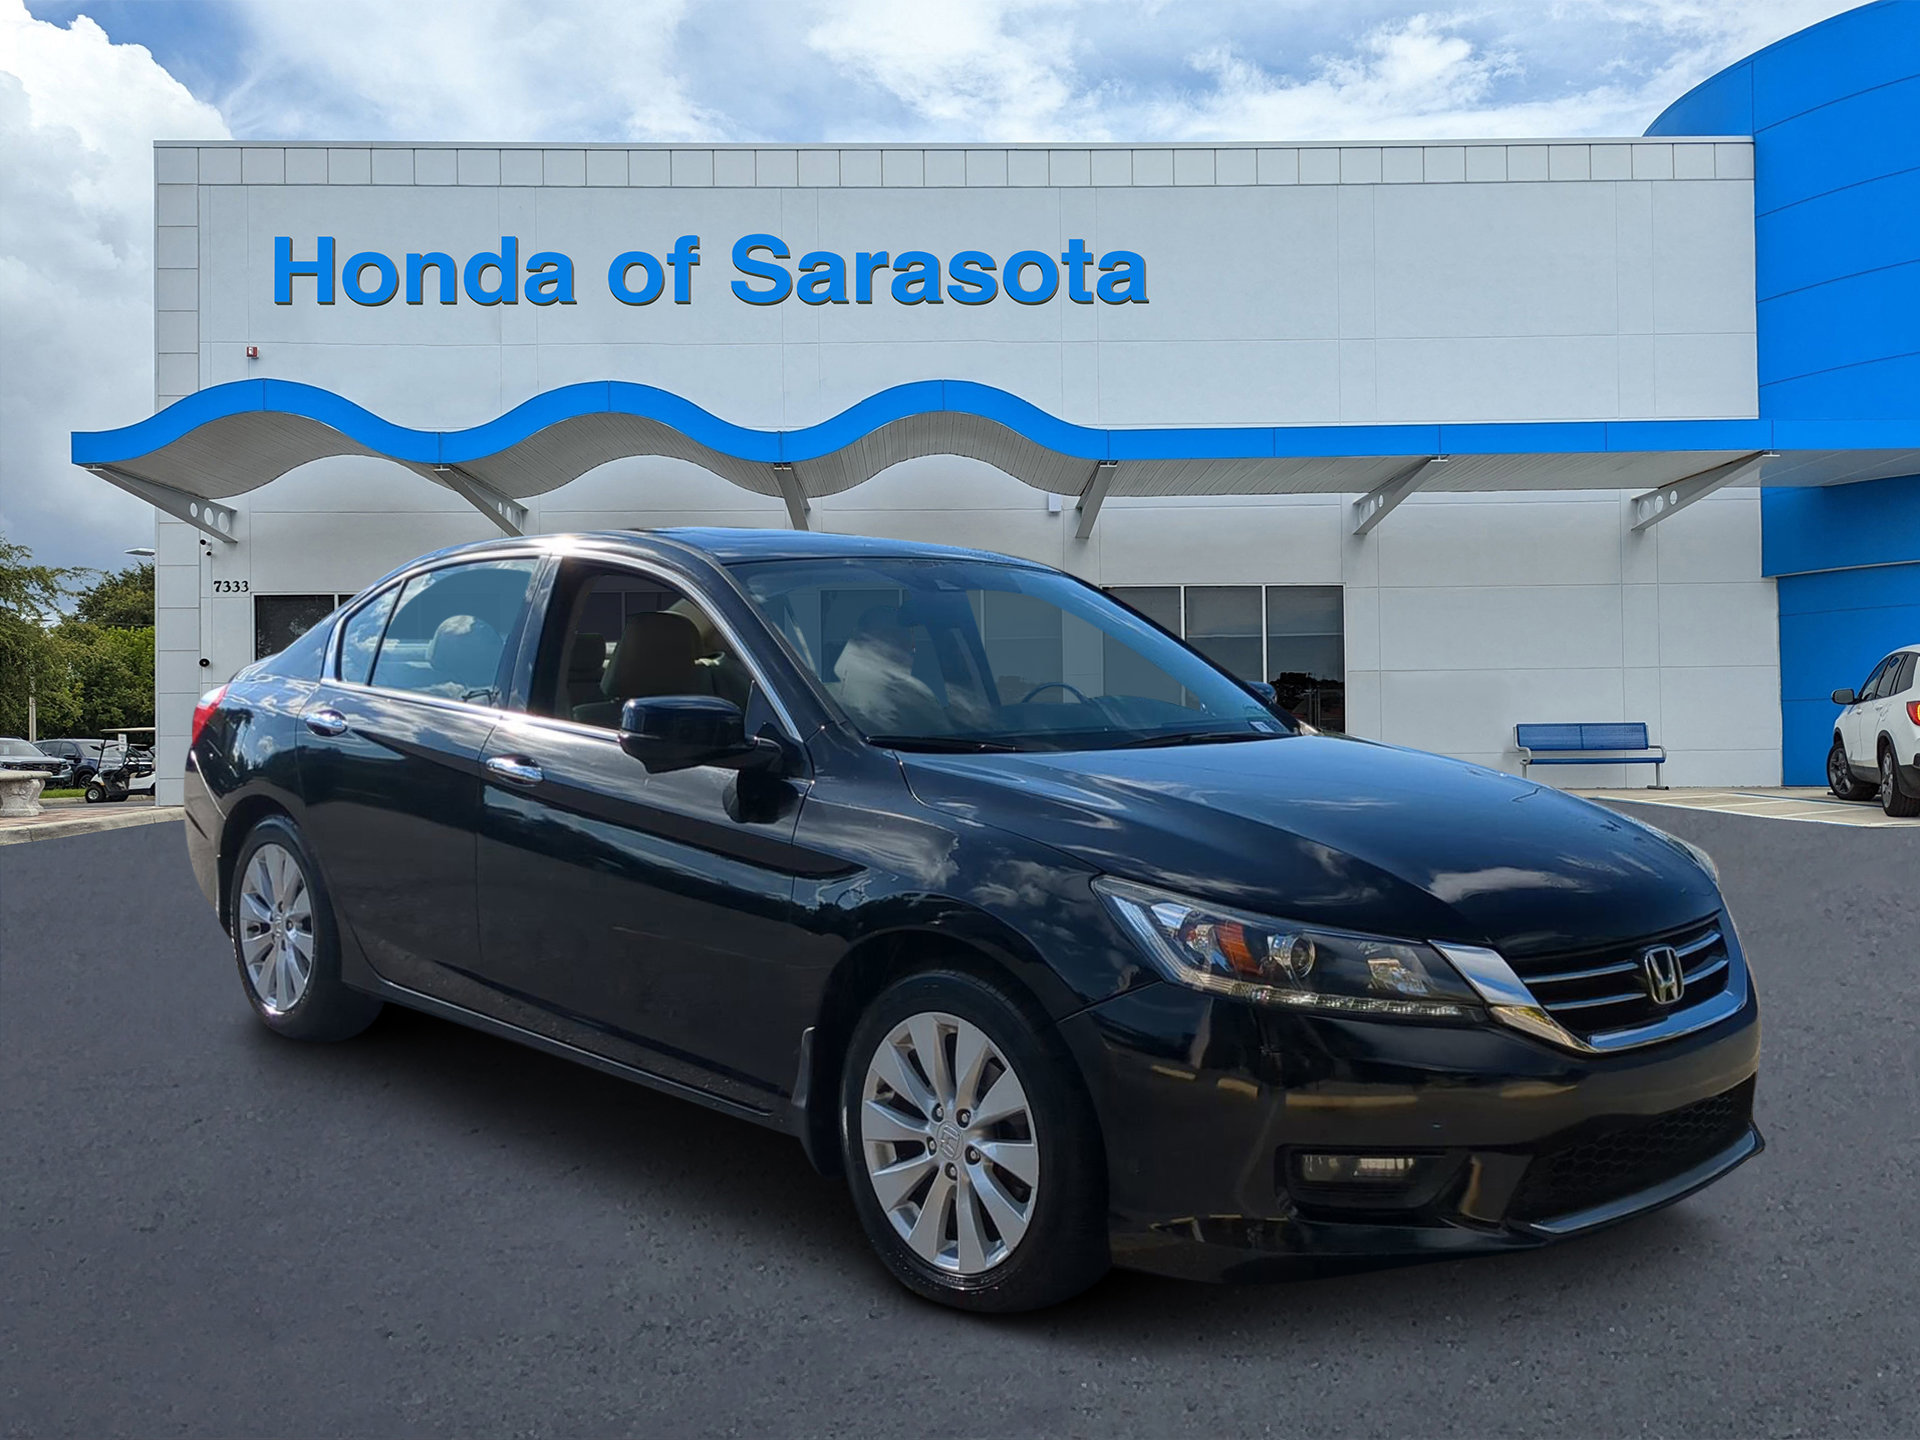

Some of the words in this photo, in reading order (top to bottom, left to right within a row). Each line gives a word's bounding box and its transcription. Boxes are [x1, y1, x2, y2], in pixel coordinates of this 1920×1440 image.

[273, 235, 577, 306] Honda
[607, 234, 701, 306] of
[730, 233, 1150, 306] Sarasota
[213, 580, 249, 593] 7333
